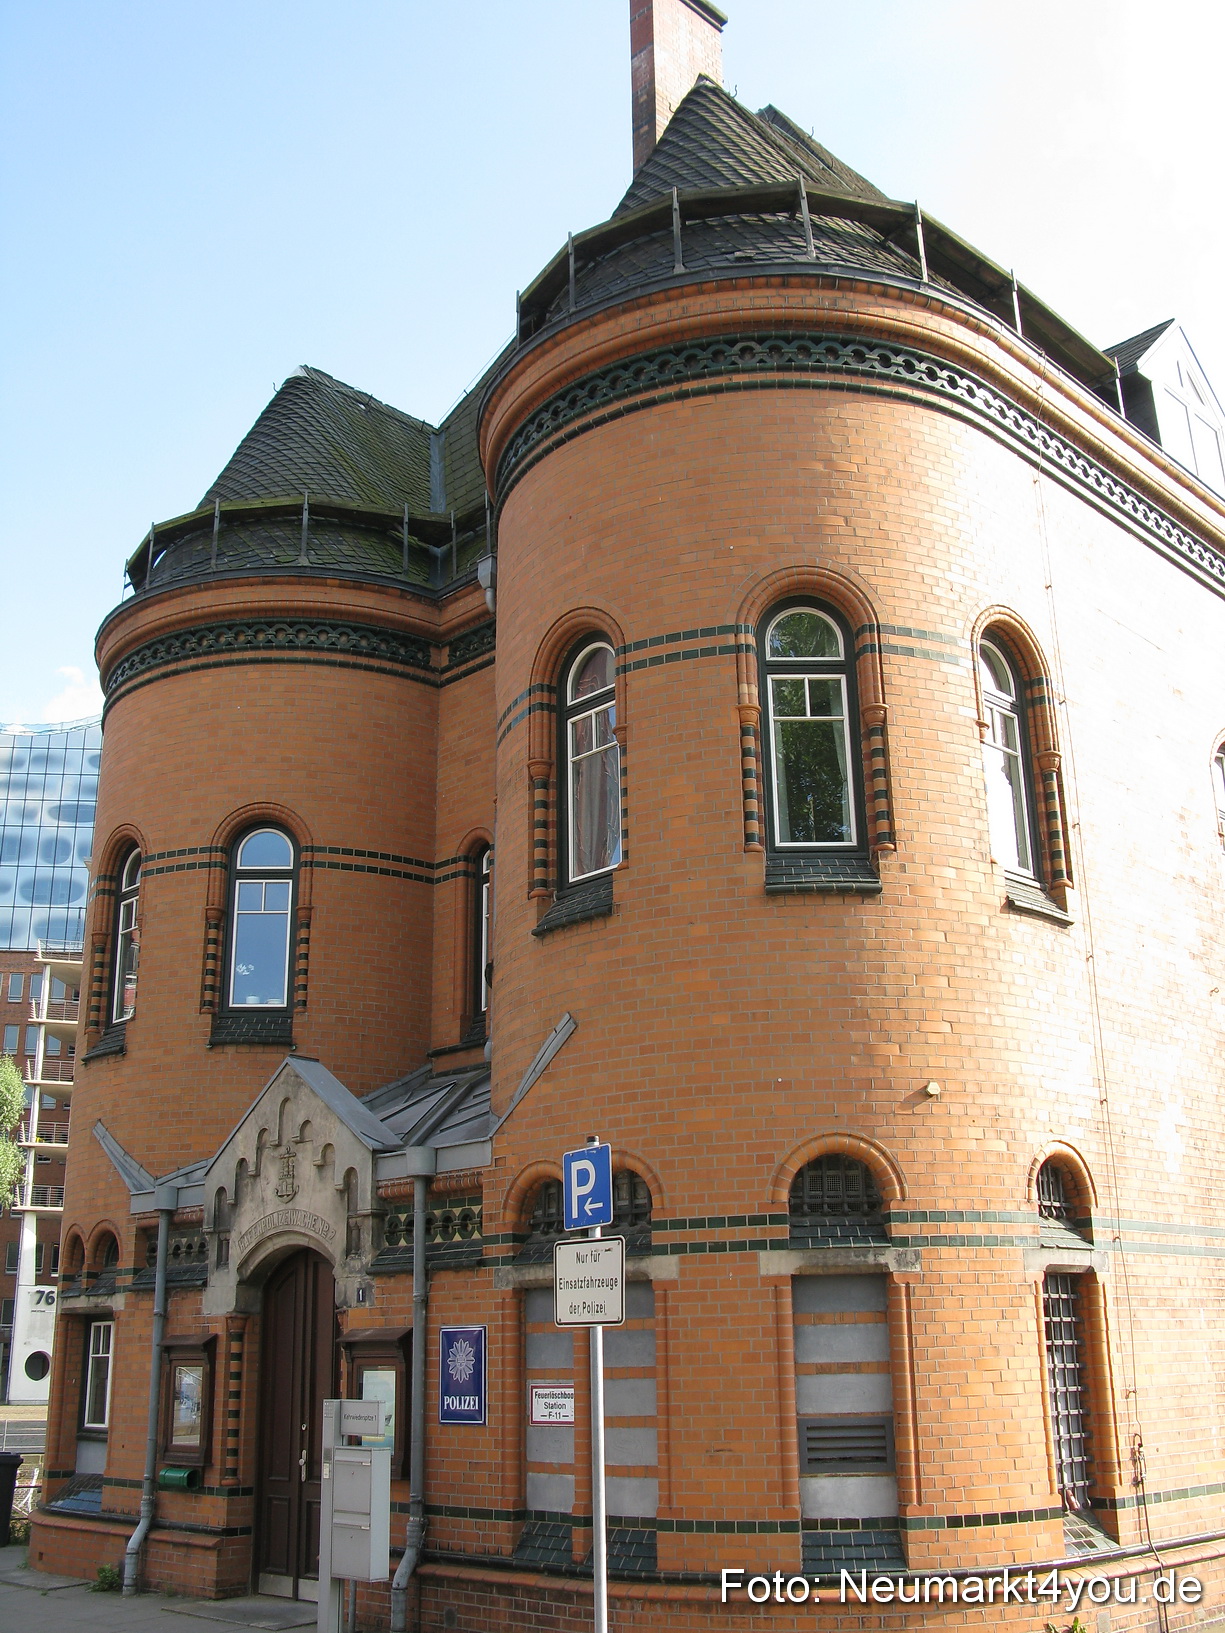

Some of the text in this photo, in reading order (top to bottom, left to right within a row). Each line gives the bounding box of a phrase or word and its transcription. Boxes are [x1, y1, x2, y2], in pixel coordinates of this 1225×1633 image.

[571, 1160, 596, 1218] P
[576, 1250, 600, 1264] Nur für
[559, 1276, 618, 1290] Einsatzfahrzeuge
[35, 1290, 56, 1306] 76
[569, 1300, 606, 1315] der Polizei
[534, 1390, 574, 1399] Feuerlöschboo
[444, 1395, 479, 1410] POLIZEI
[543, 1401, 567, 1410] Station
